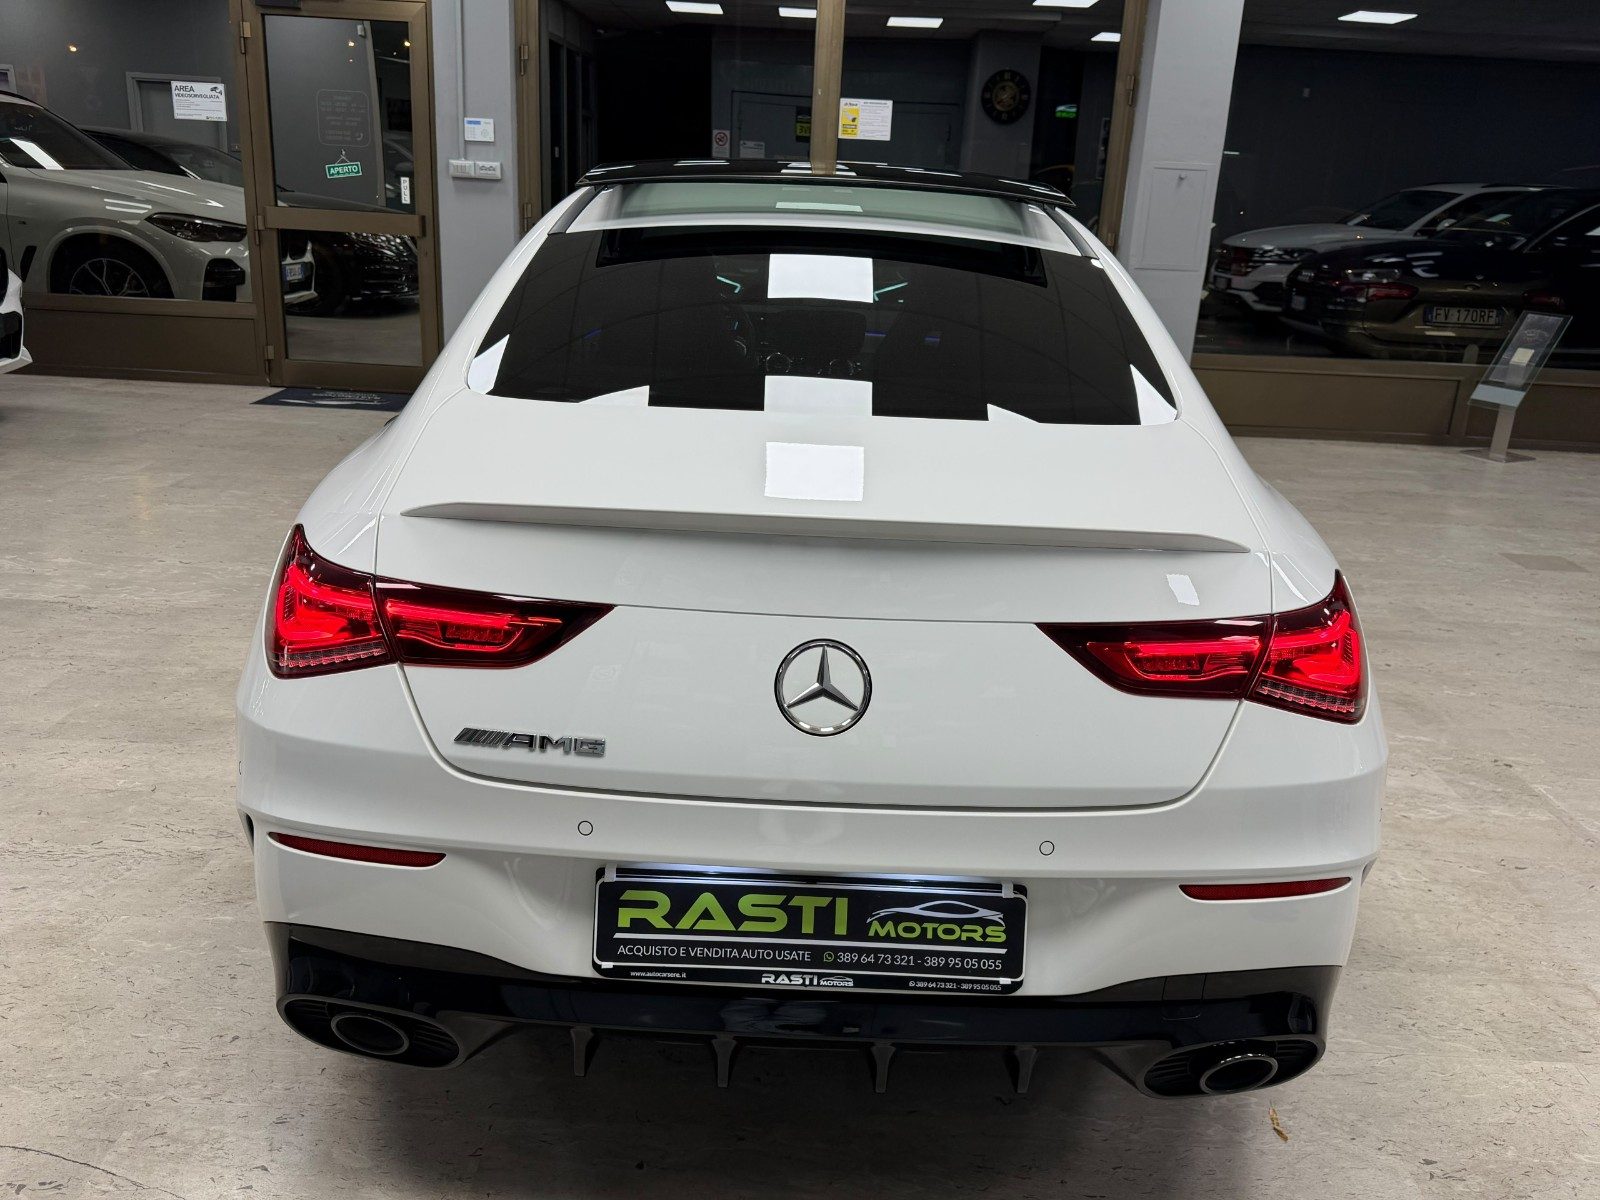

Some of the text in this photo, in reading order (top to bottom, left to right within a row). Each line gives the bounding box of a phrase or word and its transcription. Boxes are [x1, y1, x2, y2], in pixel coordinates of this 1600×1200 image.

[329, 165, 359, 175] APERTO
[1434, 307, 1450, 321] FV
[618, 889, 849, 936] RASTI
[868, 920, 1007, 943] MOTORS
[617, 945, 678, 957] ACQUISTO
[680, 946, 686, 956] E
[689, 947, 739, 958] VENDITA
[741, 949, 774, 960] AUTO
[776, 950, 811, 961] USATE
[837, 952, 858, 964] 389
[860, 953, 875, 964] 64
[877, 954, 892, 965] 73
[894, 954, 915, 966] 321
[924, 956, 945, 967] 389
[948, 957, 962, 968] 95
[964, 958, 979, 969] 05
[980, 959, 1002, 970] 055
[761, 973, 818, 986] RASTI
